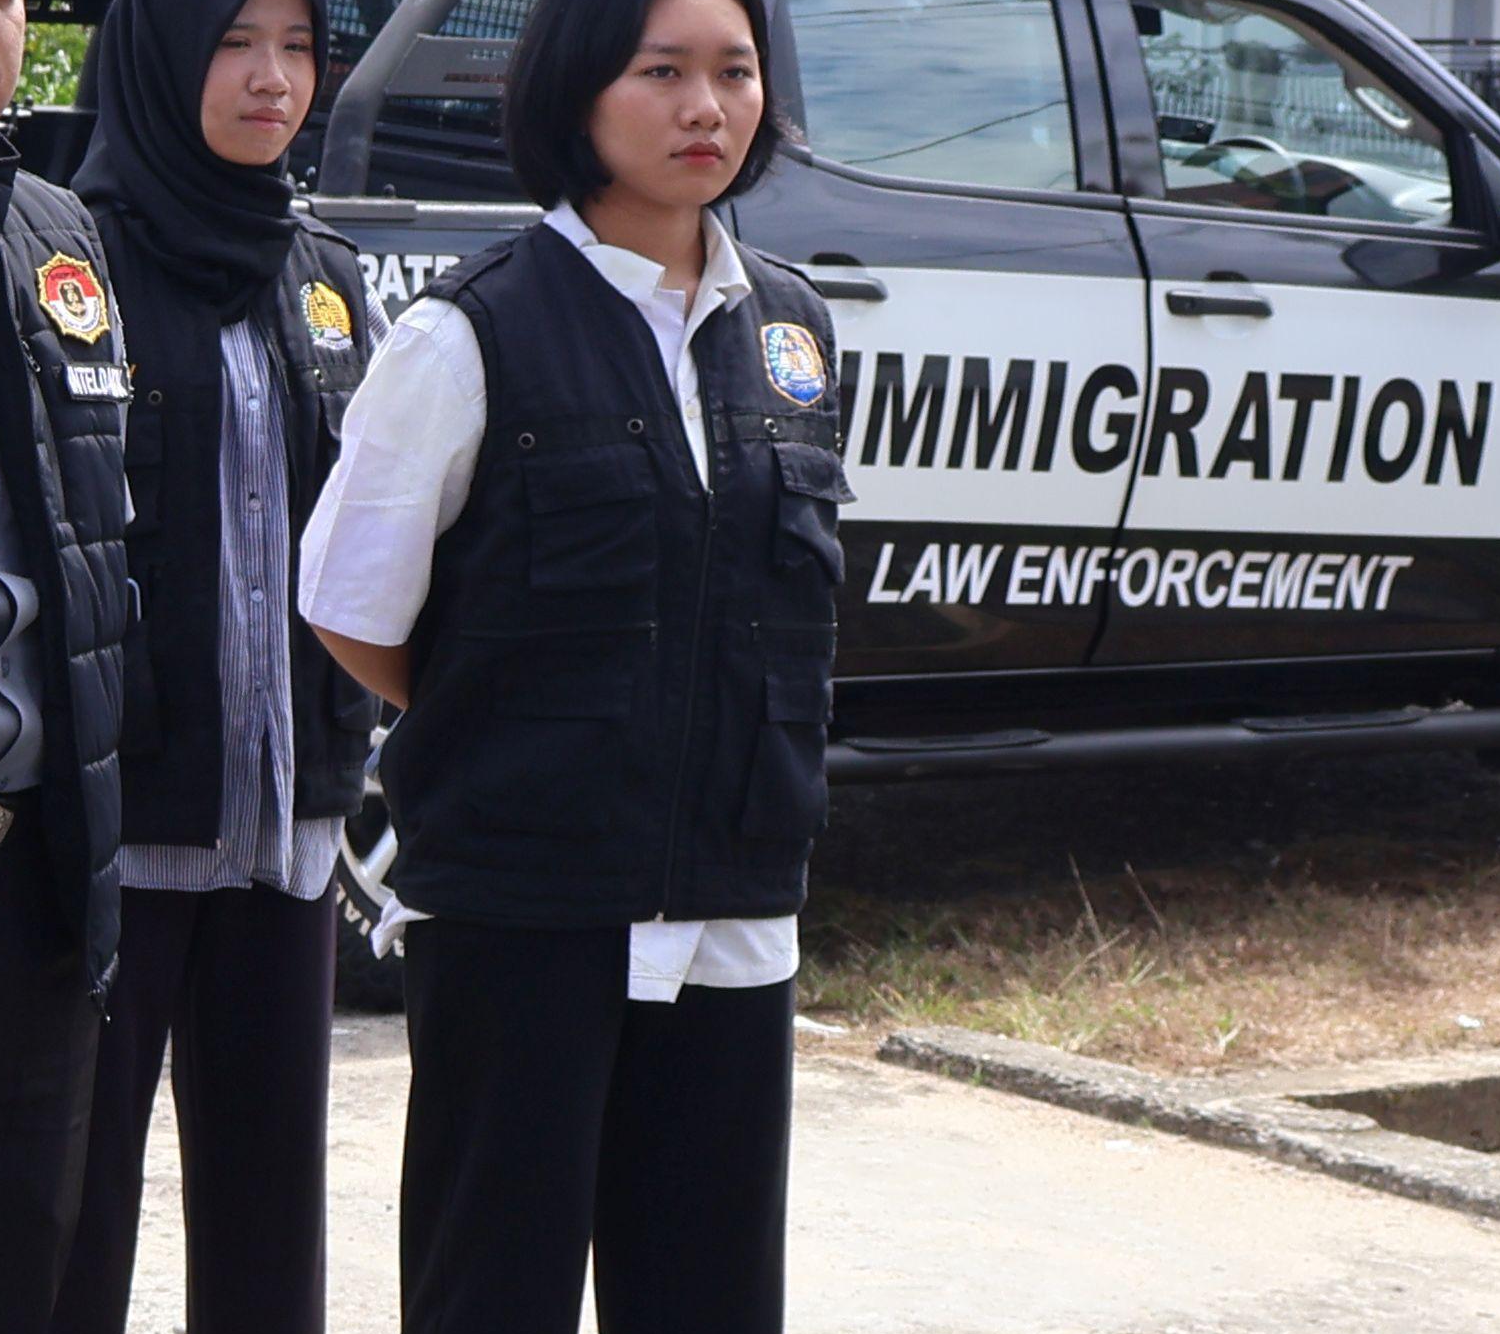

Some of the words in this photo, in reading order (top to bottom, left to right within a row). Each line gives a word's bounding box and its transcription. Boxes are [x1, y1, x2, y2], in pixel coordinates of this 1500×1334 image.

[838, 350, 1493, 486] IMMIGRATION
[866, 543, 1003, 604] LAW
[1004, 545, 1414, 611] ENFORCEMENT
